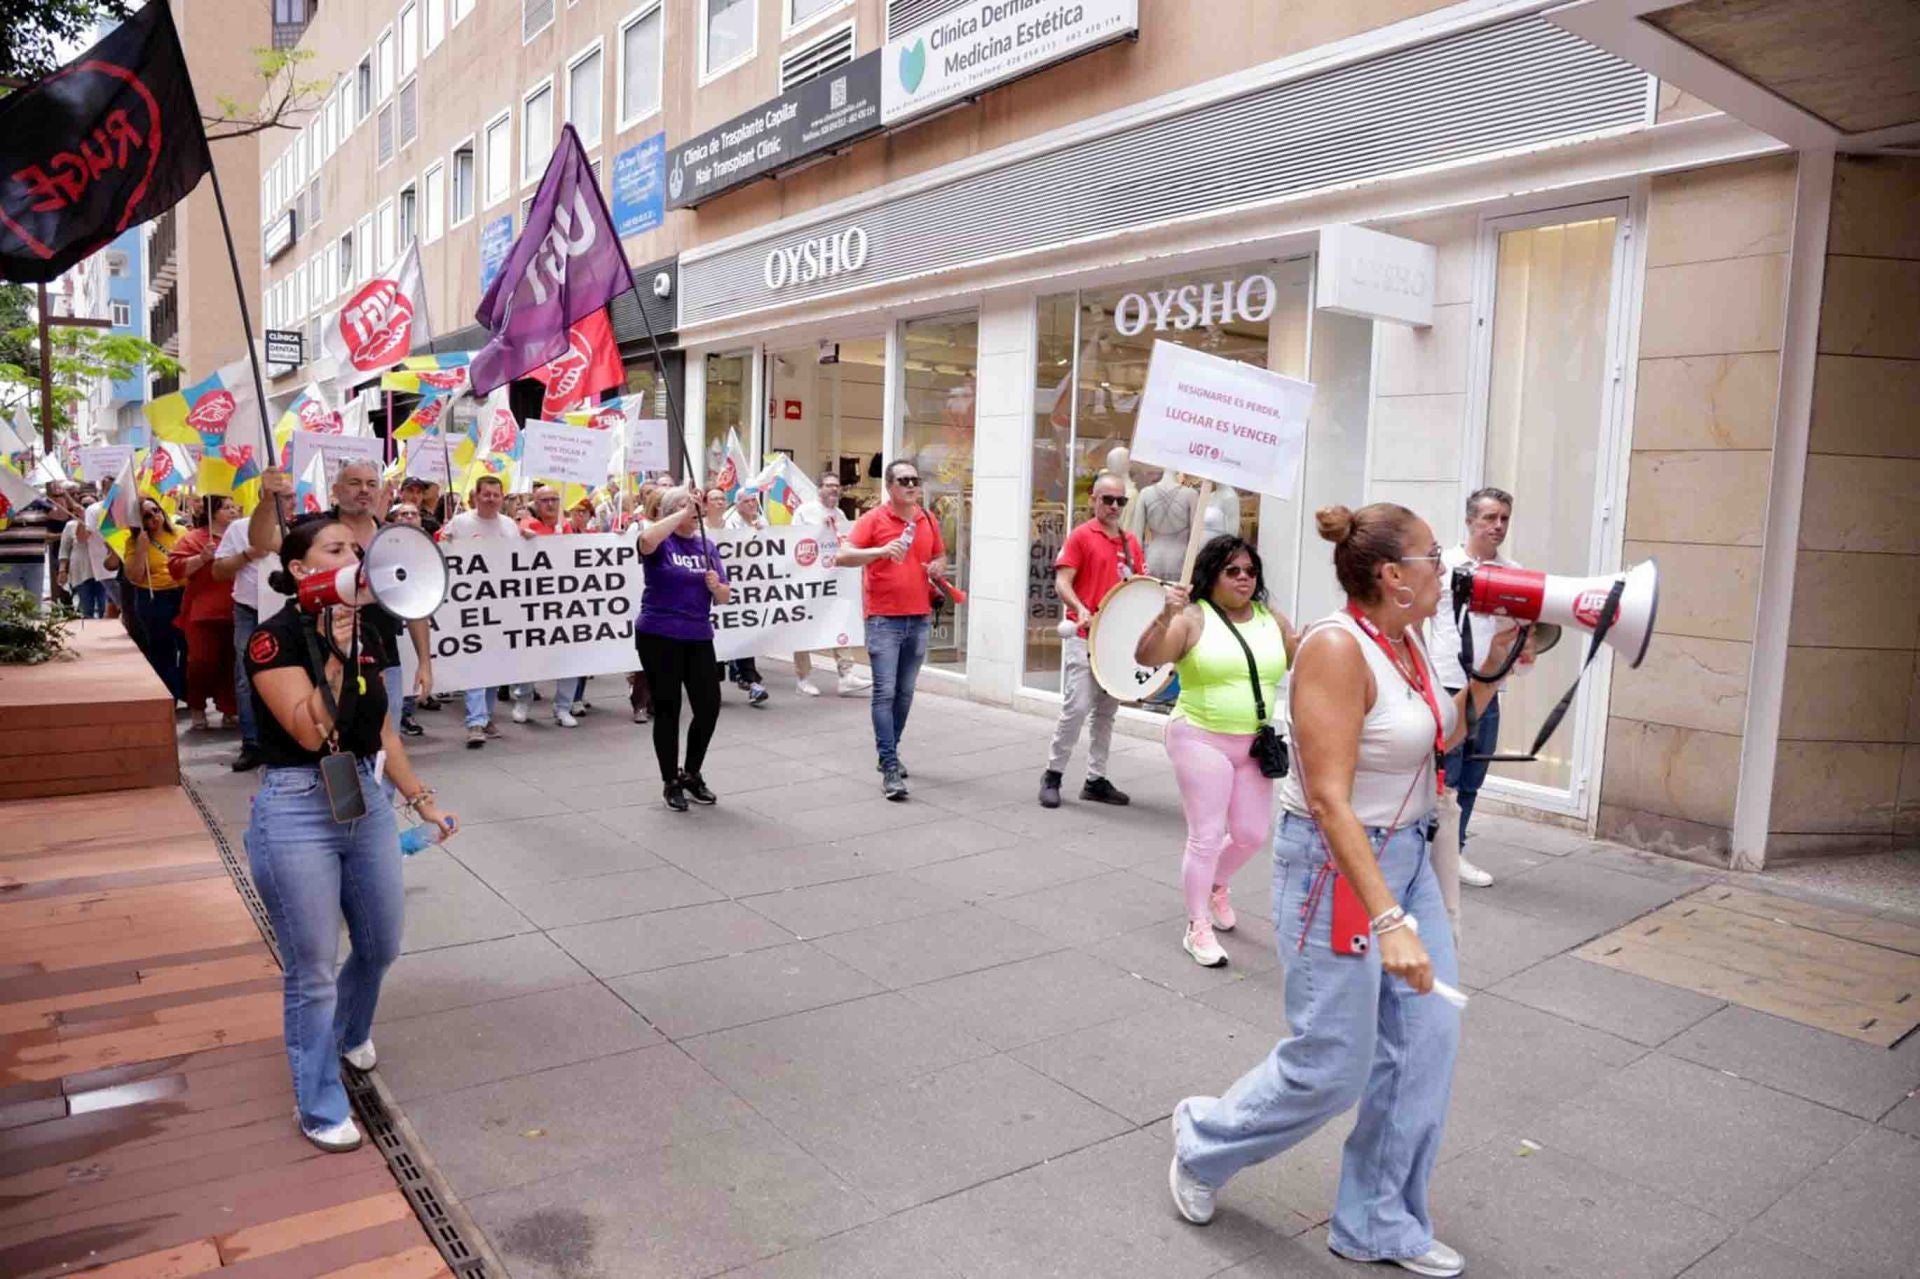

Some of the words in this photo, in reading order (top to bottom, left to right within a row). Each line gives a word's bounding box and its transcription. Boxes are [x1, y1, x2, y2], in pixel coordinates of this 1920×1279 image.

[930, 20, 977, 51] Clínica
[982, 0, 1043, 28] Derma
[944, 32, 1012, 77] Medicina
[1016, 5, 1083, 47] Estética
[765, 102, 798, 129] Capilar
[695, 166, 712, 186] Hair
[765, 226, 868, 289] OYSHO
[1113, 274, 1277, 336] OYSHO
[1178, 381, 1232, 406] RESIGNARSE
[1233, 399, 1245, 409] ES
[1166, 406, 1214, 429] LUCHAR
[1216, 419, 1230, 433] ES
[1232, 423, 1278, 446] VENCER
[511, 551, 552, 572] LA
[672, 552, 700, 569] UGT
[444, 572, 626, 603] CARIEDAD
[460, 606, 501, 628] EL
[521, 596, 630, 622] TRATO
[713, 580, 838, 606] GRANTE
[430, 633, 483, 658] OS
[503, 620, 634, 649] TRABAJ
